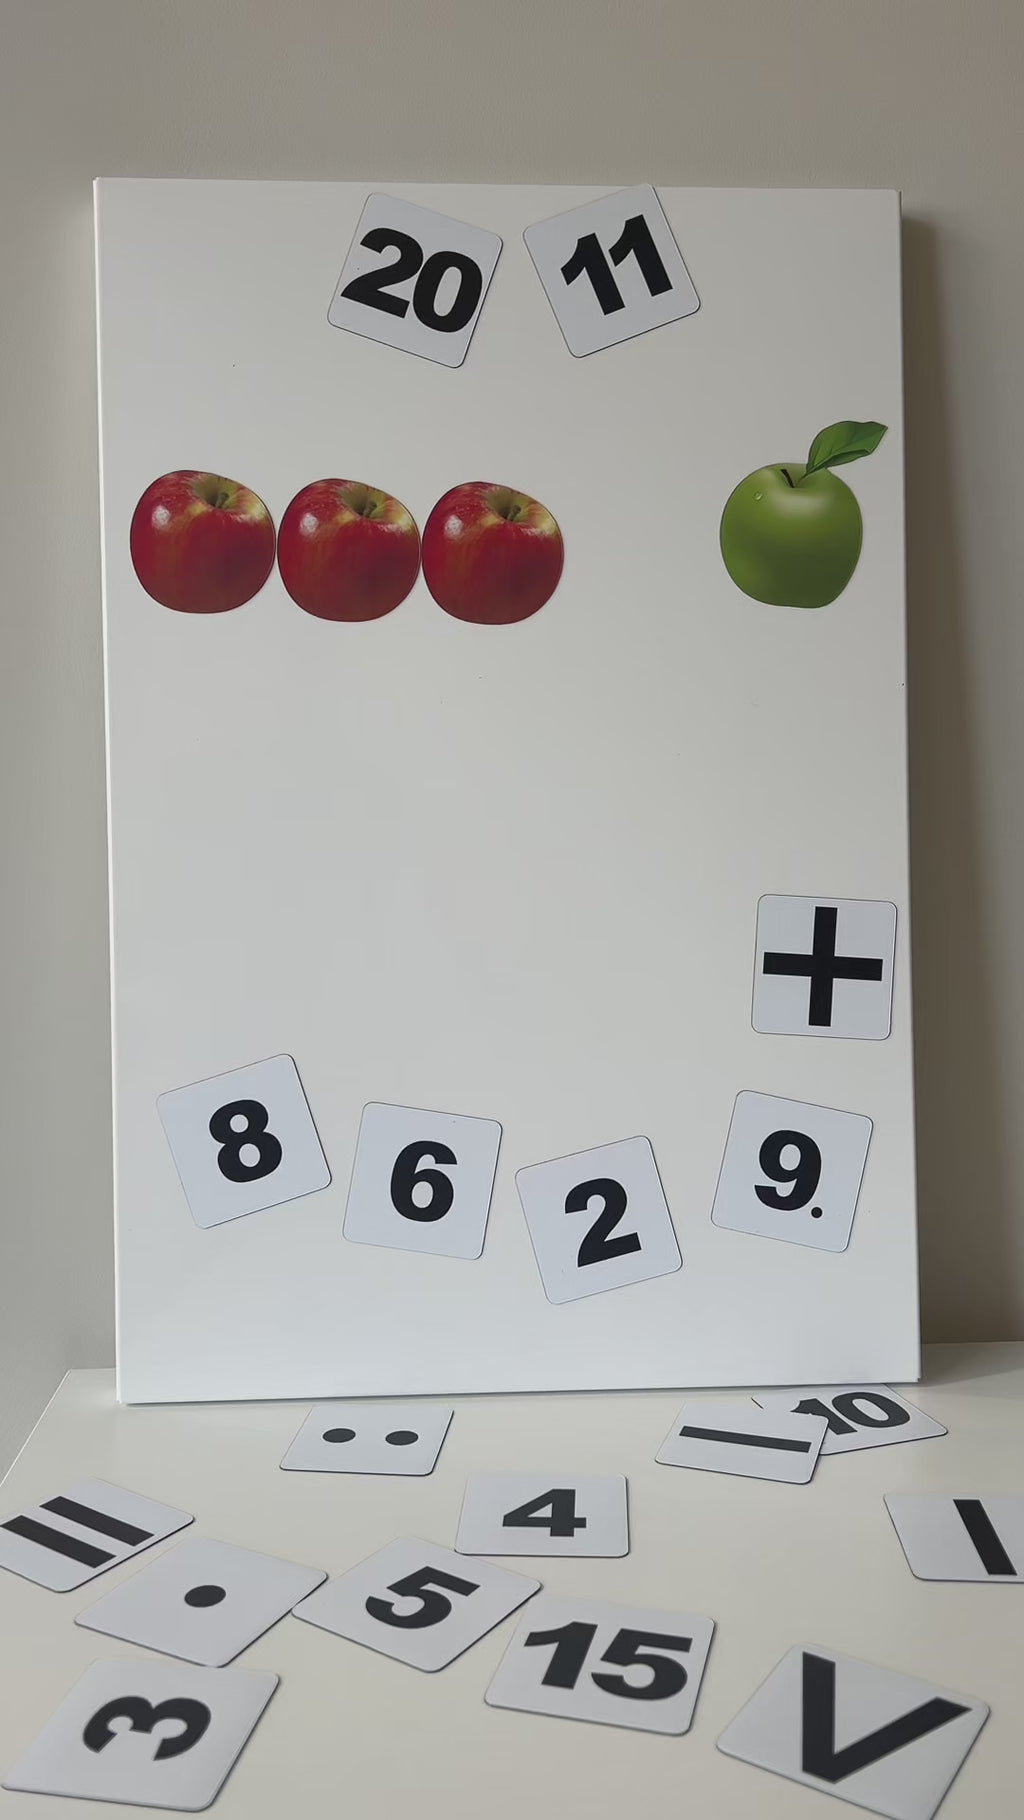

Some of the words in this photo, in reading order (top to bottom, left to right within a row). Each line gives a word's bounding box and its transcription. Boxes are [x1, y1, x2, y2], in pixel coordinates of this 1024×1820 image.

[341, 228, 483, 333] 20
[560, 214, 674, 316] 11
[208, 1099, 283, 1183] 8
[390, 1140, 458, 1223] 6
[754, 1130, 823, 1219] 9.
[564, 1177, 642, 1268] 2
[502, 1488, 587, 1538] 4
[365, 1565, 481, 1630] 5
[523, 1621, 693, 1701] 15
[82, 1696, 211, 1761] 3
